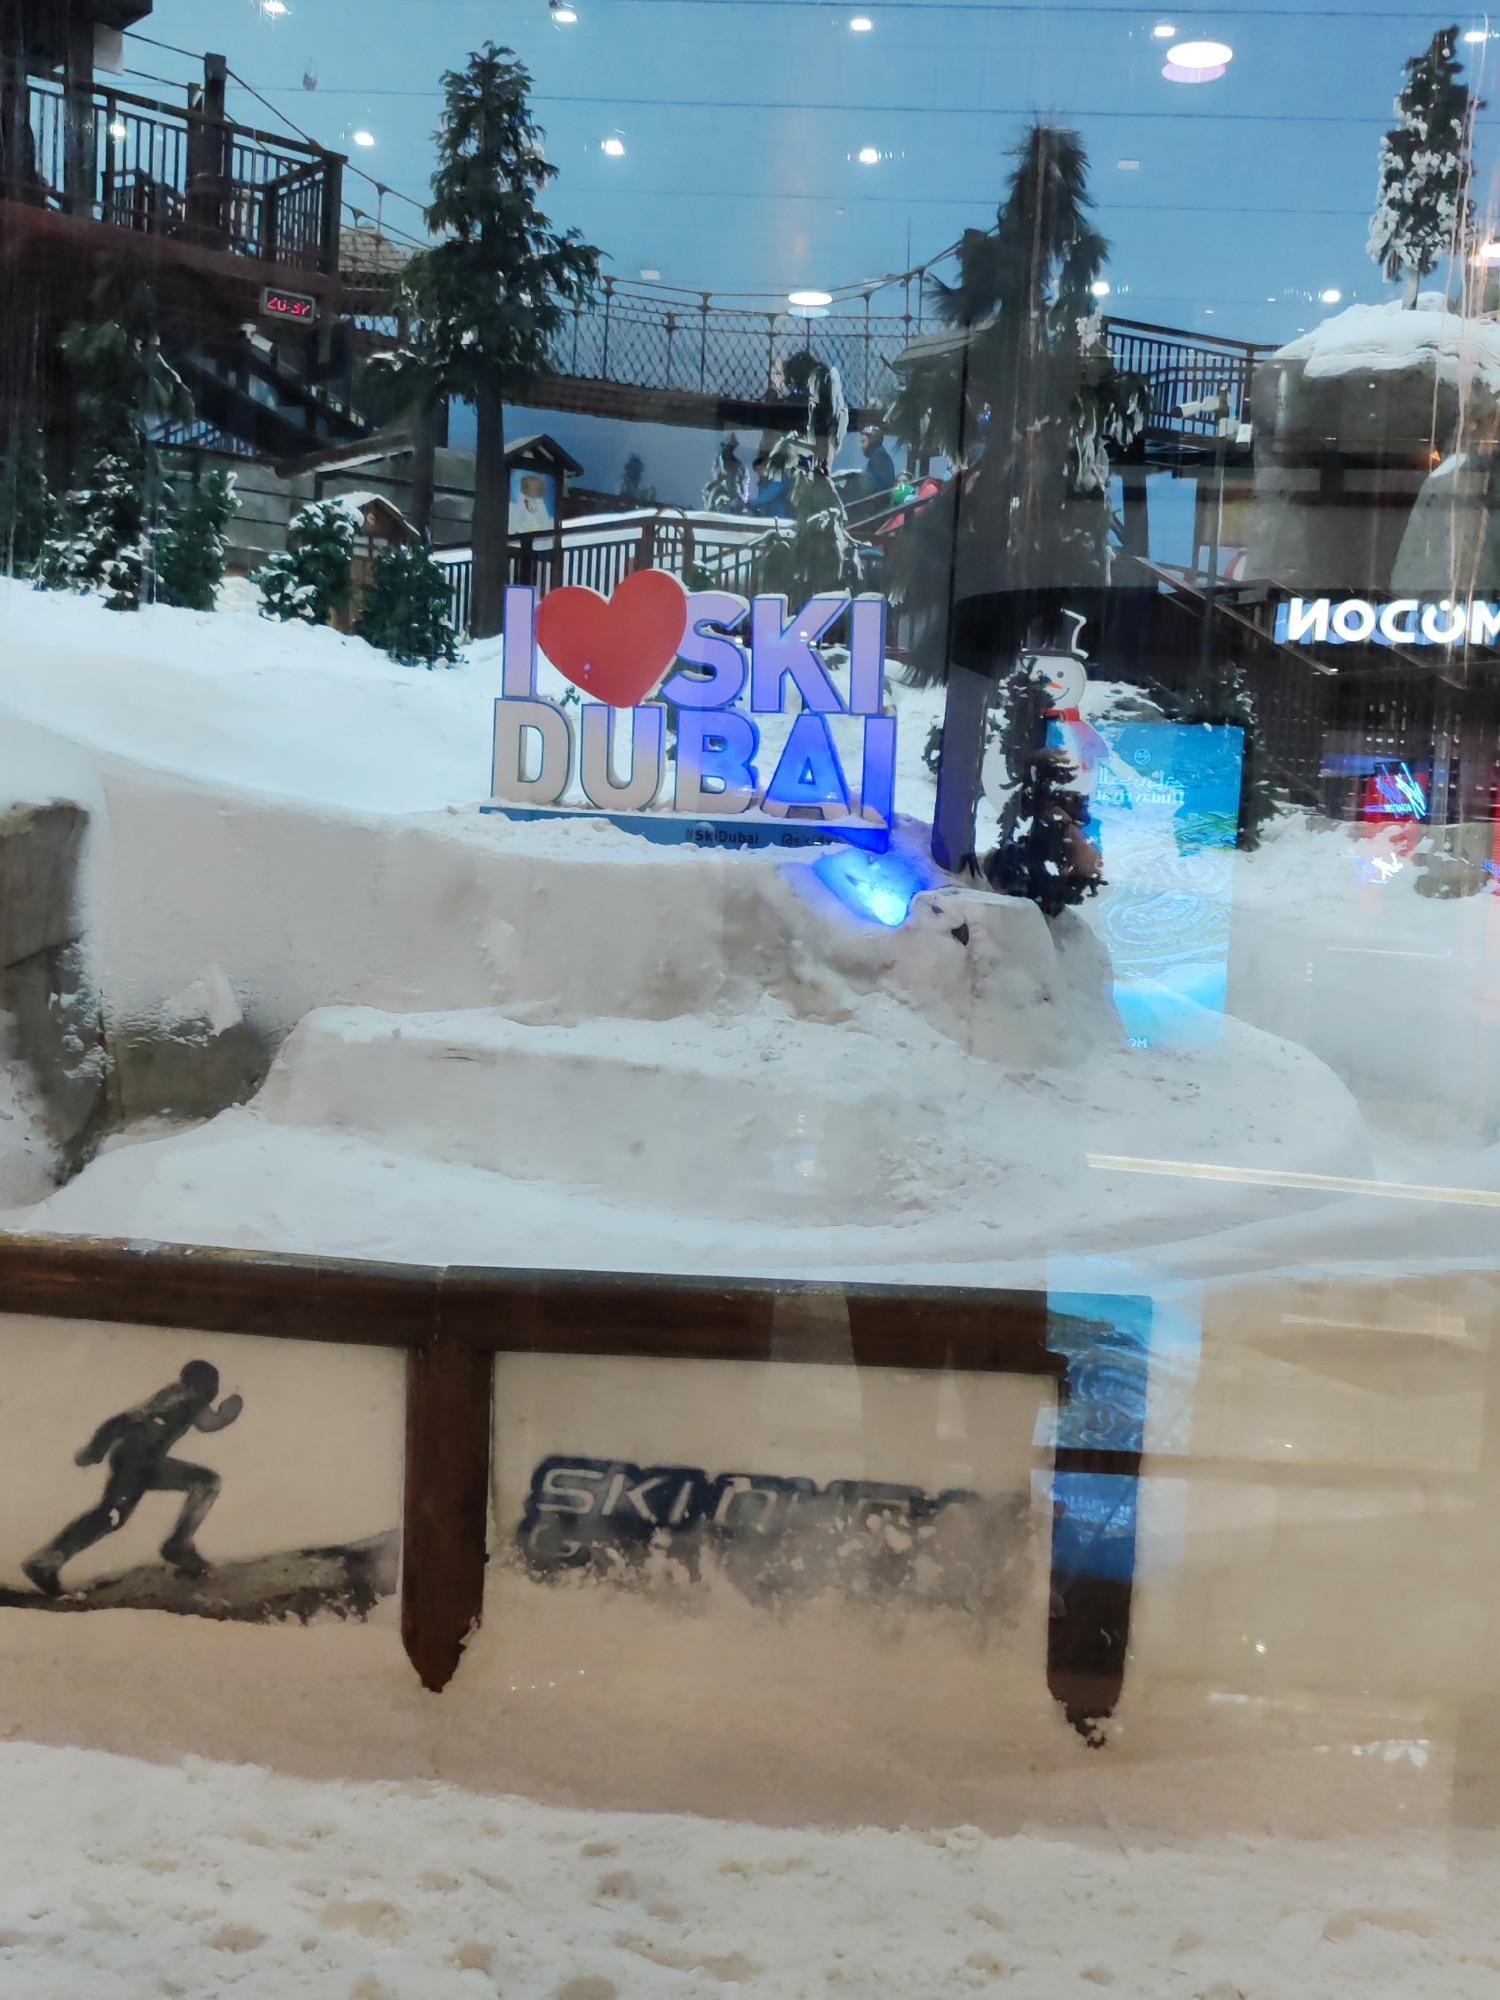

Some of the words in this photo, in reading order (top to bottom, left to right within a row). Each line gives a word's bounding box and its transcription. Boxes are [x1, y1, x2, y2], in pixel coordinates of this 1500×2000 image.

[503, 585, 536, 699] I
[660, 590, 887, 716] SKI
[491, 698, 897, 826] DUBAI
[685, 828, 759, 844] #SkiDubai
[535, 1466, 696, 1524] SKI
